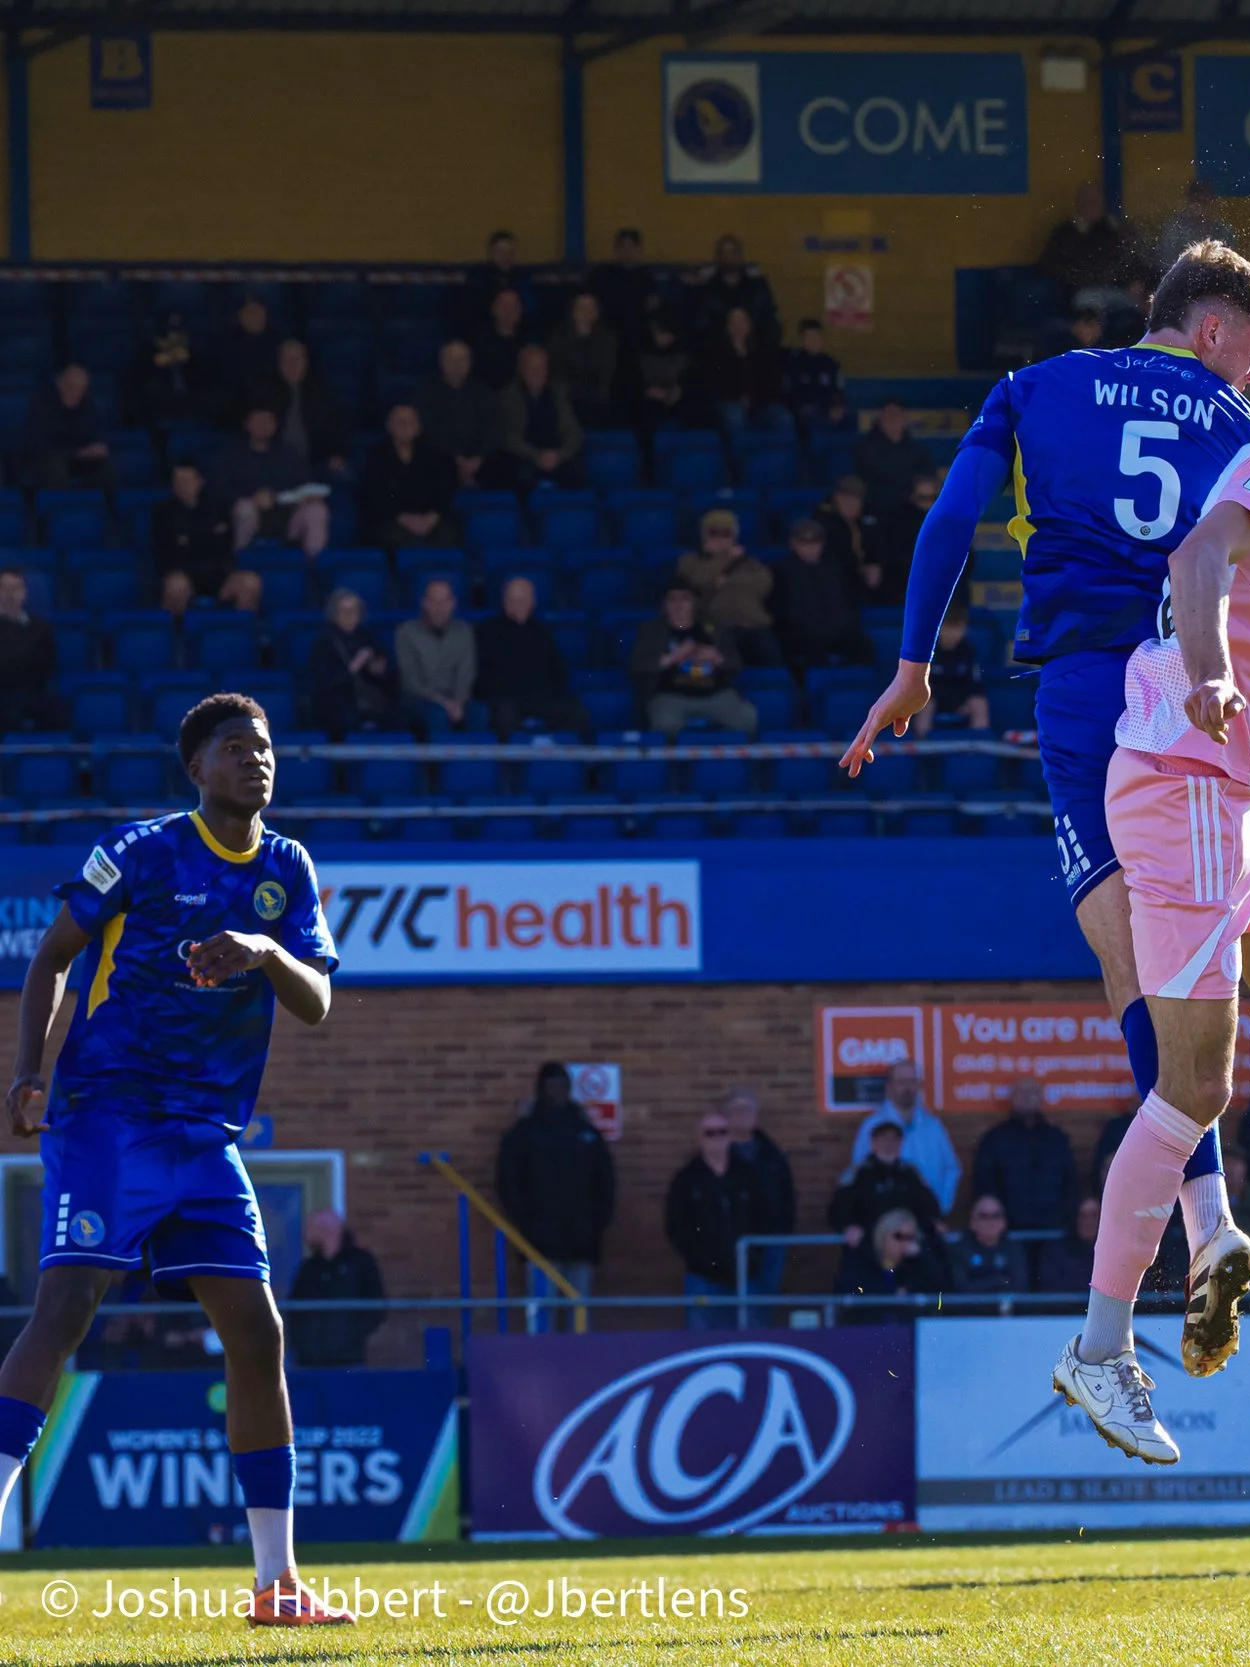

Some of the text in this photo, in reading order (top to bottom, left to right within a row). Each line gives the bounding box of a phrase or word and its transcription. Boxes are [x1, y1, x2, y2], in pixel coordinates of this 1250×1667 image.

[102, 39, 141, 79] B
[1131, 63, 1175, 102] C
[798, 97, 1008, 156] COME
[1094, 378, 1216, 432] WILSON
[1113, 420, 1182, 540] 5
[454, 884, 692, 950] health
[952, 1012, 1017, 1043] You
[1020, 1015, 1077, 1043] are
[838, 1037, 909, 1068] GMB
[331, 1426, 382, 1446] 2022
[553, 1361, 818, 1523] ACA
[89, 1451, 404, 1509] WINERS
[786, 1501, 904, 1521] AUCTIONS
